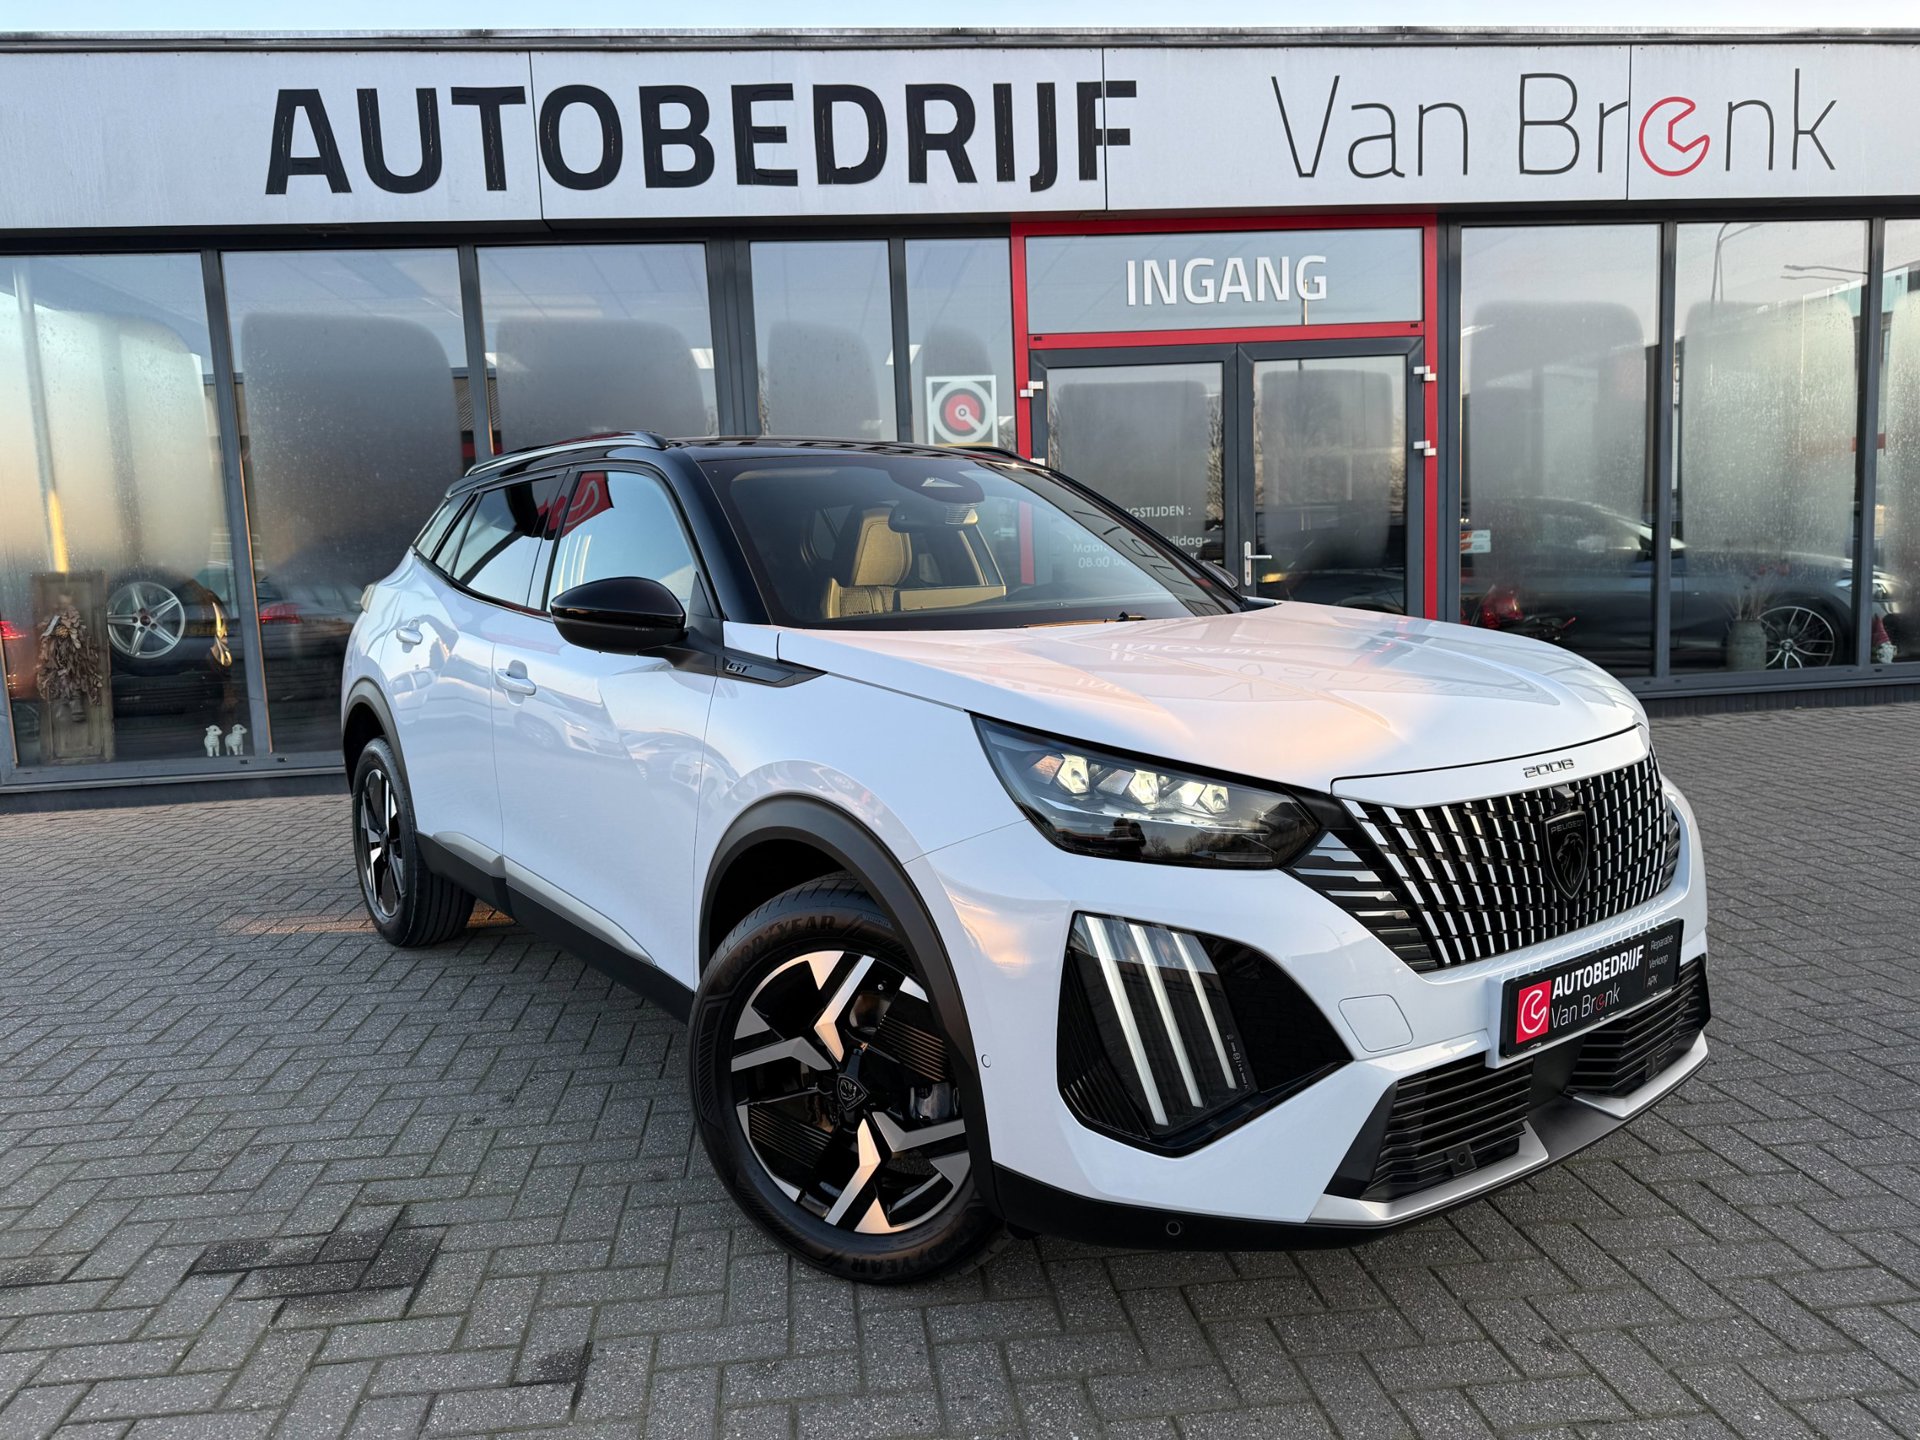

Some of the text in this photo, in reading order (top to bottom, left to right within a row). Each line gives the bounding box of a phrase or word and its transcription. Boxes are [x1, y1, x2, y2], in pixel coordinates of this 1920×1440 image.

[265, 80, 1137, 194] AUTOBEDRIJF
[1271, 74, 1468, 179] Van
[1126, 254, 1328, 306] INGANG
[726, 662, 753, 673] GT
[1522, 757, 1575, 778] 2008
[1550, 819, 1584, 834] PEUGEOT
[1552, 944, 1645, 1000] AUTOBEDRIJF
[1551, 1002, 1578, 1029] Van
